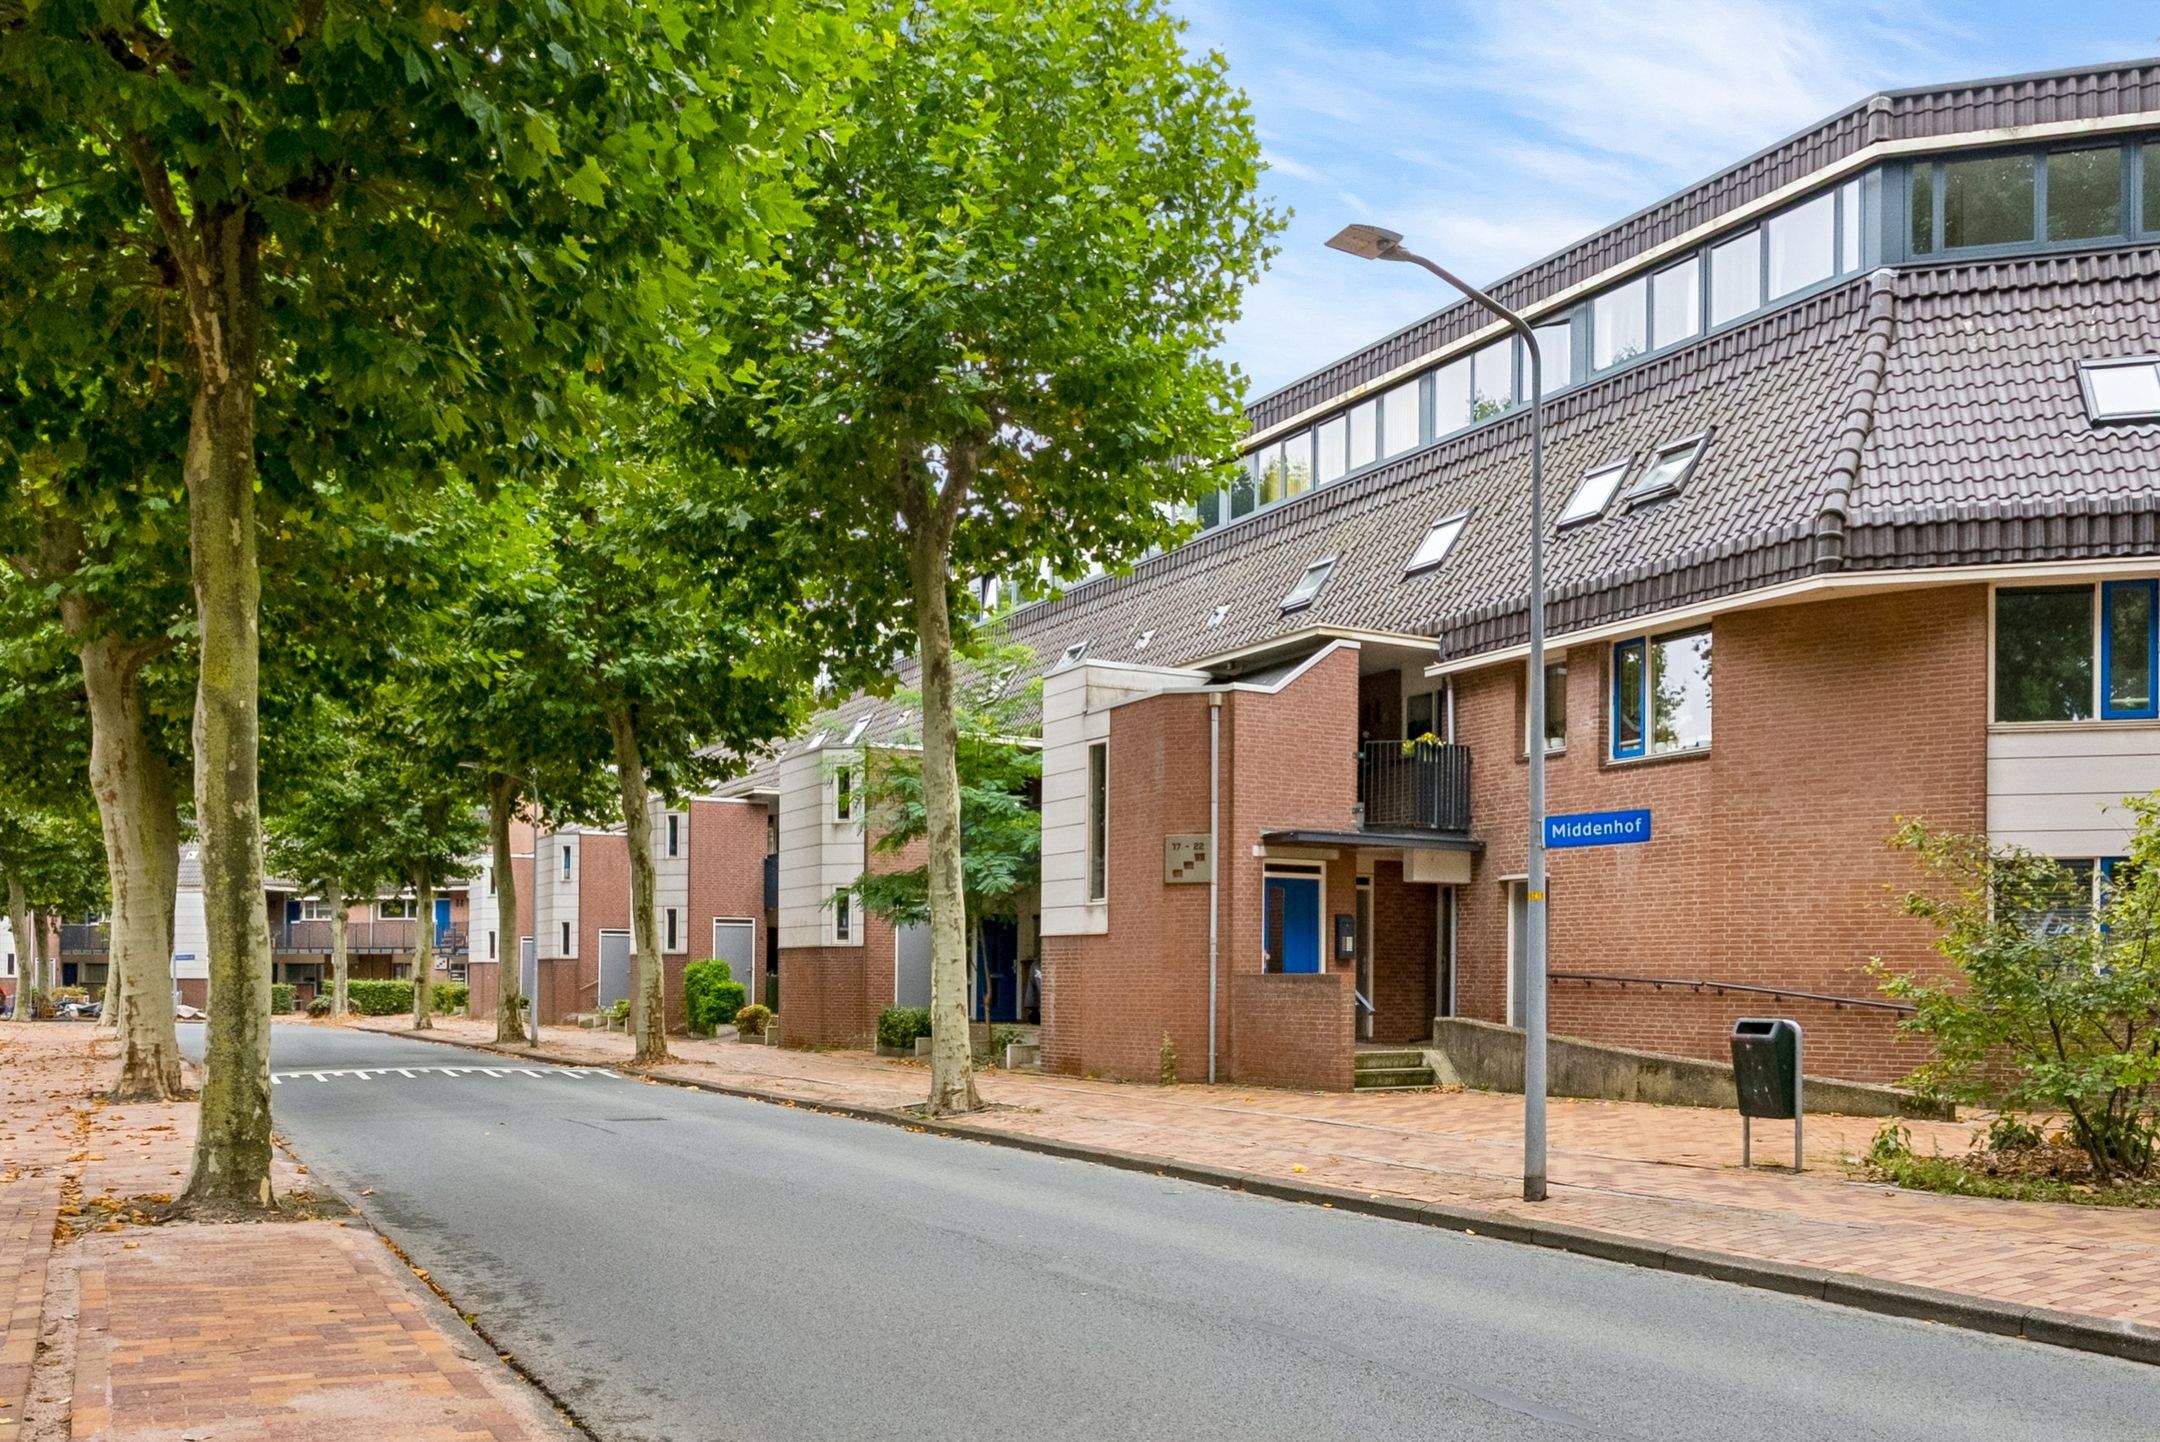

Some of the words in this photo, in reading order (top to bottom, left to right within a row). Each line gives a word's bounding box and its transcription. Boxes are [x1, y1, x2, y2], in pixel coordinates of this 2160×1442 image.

[1552, 818, 1642, 838] Middenhof
[1172, 842, 1181, 850] 17
[1193, 842, 1205, 850] 22
